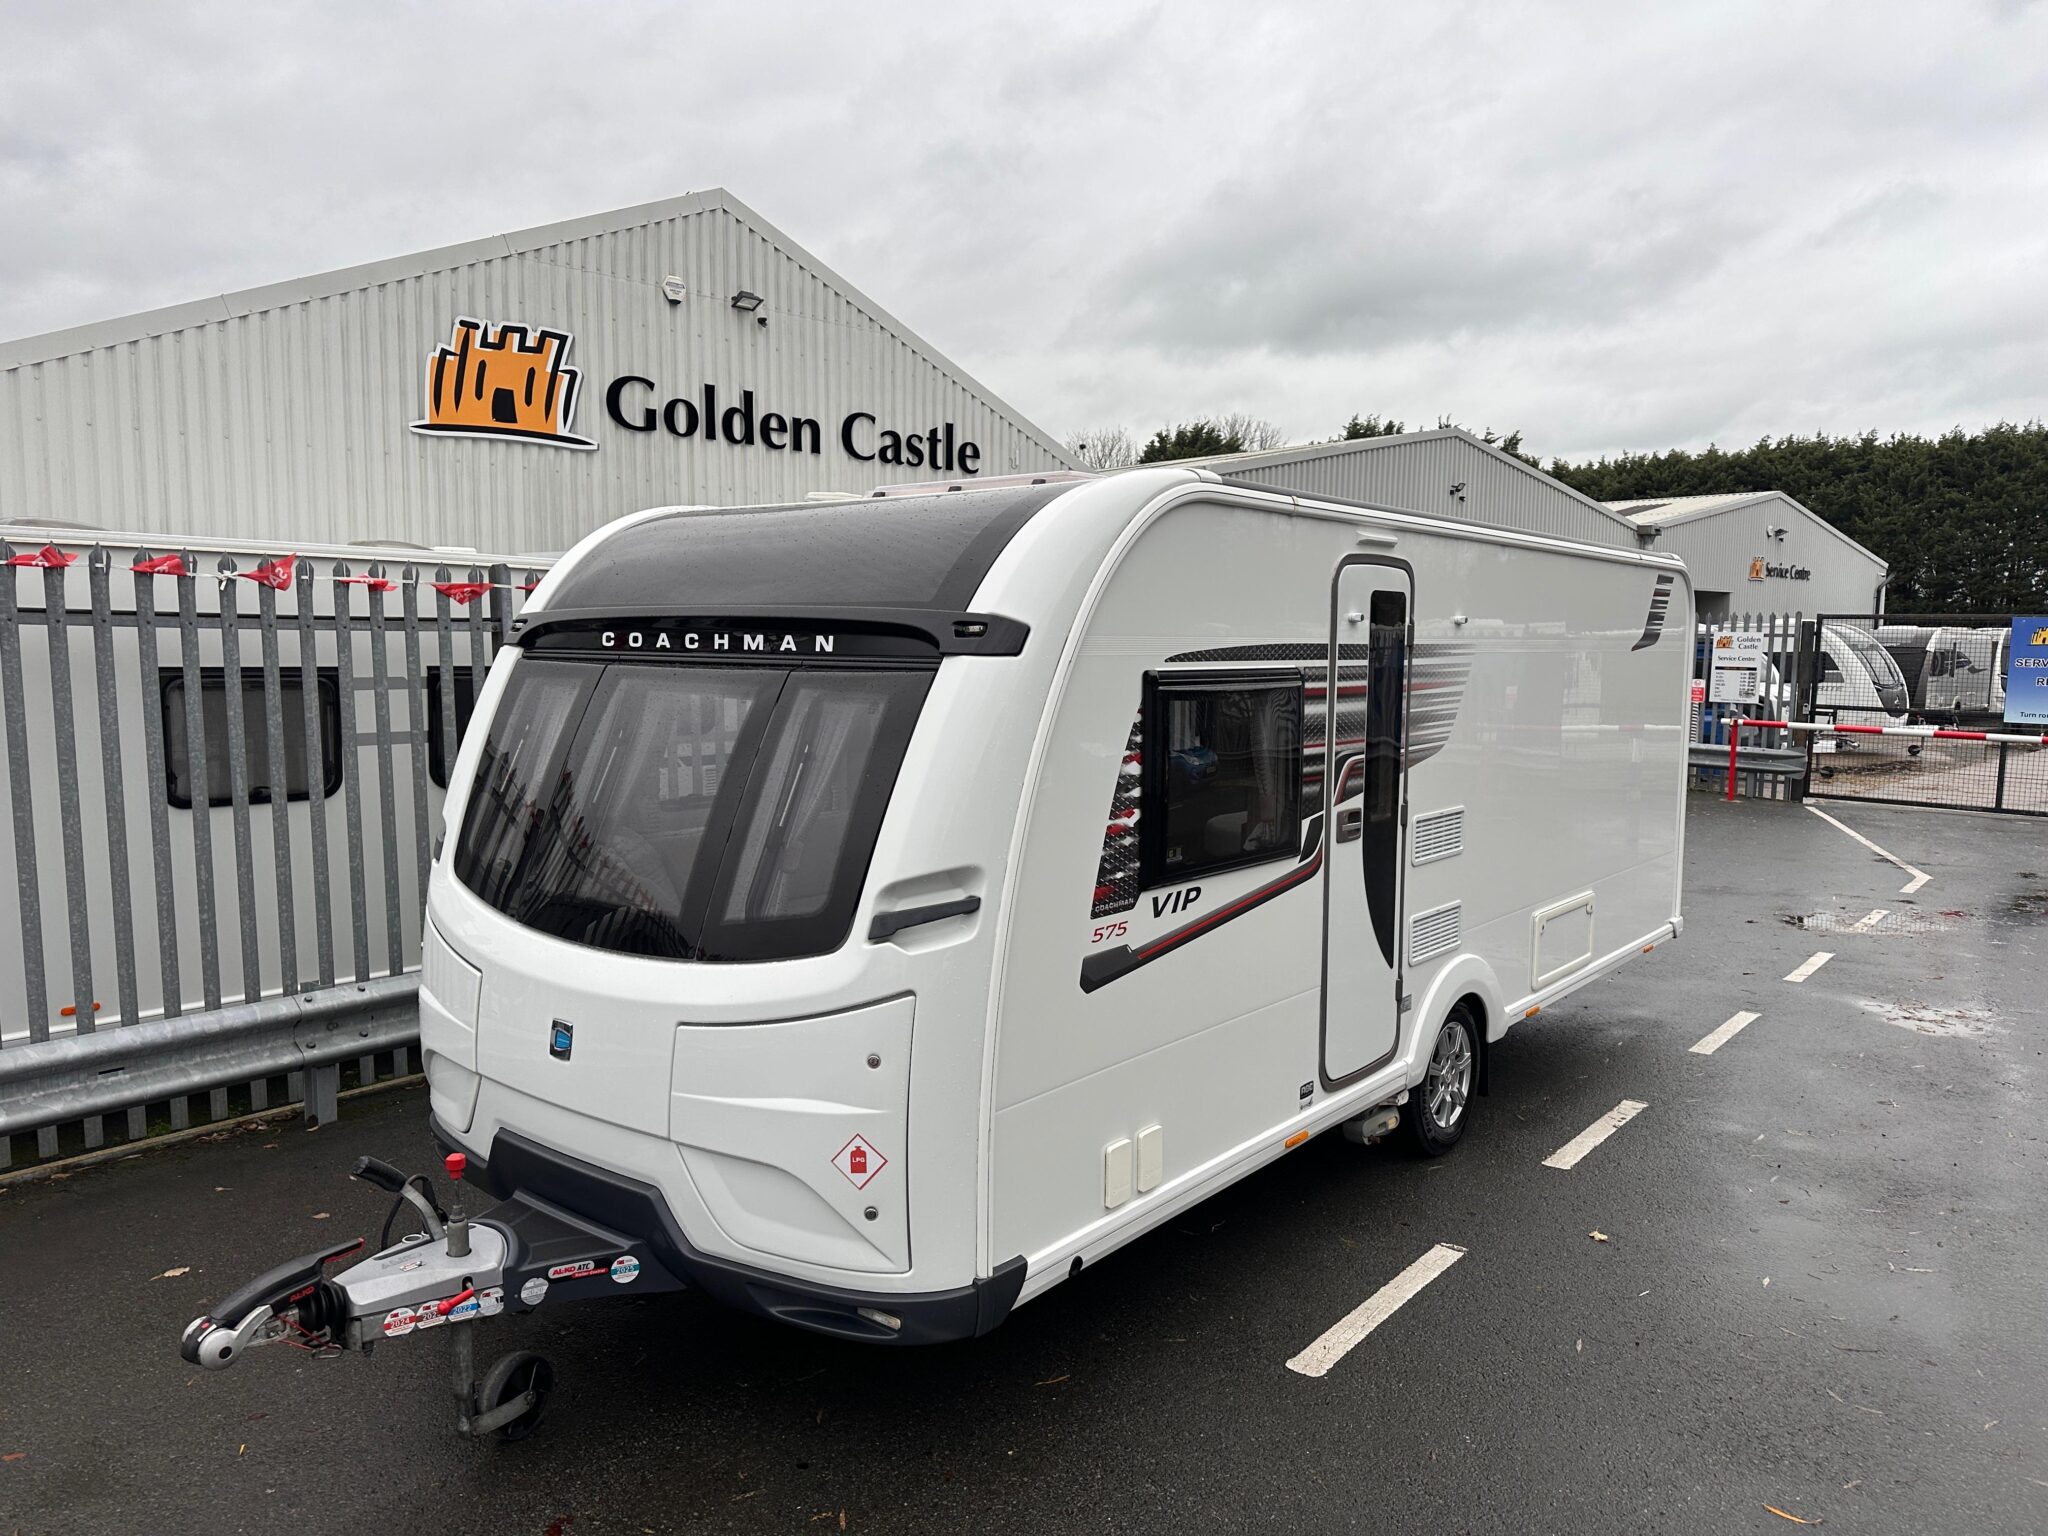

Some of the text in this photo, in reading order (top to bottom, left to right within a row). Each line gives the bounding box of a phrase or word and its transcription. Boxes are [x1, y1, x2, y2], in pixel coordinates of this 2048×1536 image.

[606, 375, 981, 474] Golden Castle
[1765, 562, 1811, 581] Service Centre
[602, 631, 834, 652] COACHMAN
[1095, 898, 1134, 912] COACHMAN
[1152, 887, 1202, 918] VIP
[1091, 921, 1128, 943] 575
[576, 1262, 591, 1271] ATC
[616, 1264, 635, 1274] 2025
[453, 1304, 473, 1315] 2022
[390, 1317, 411, 1328] 2024
